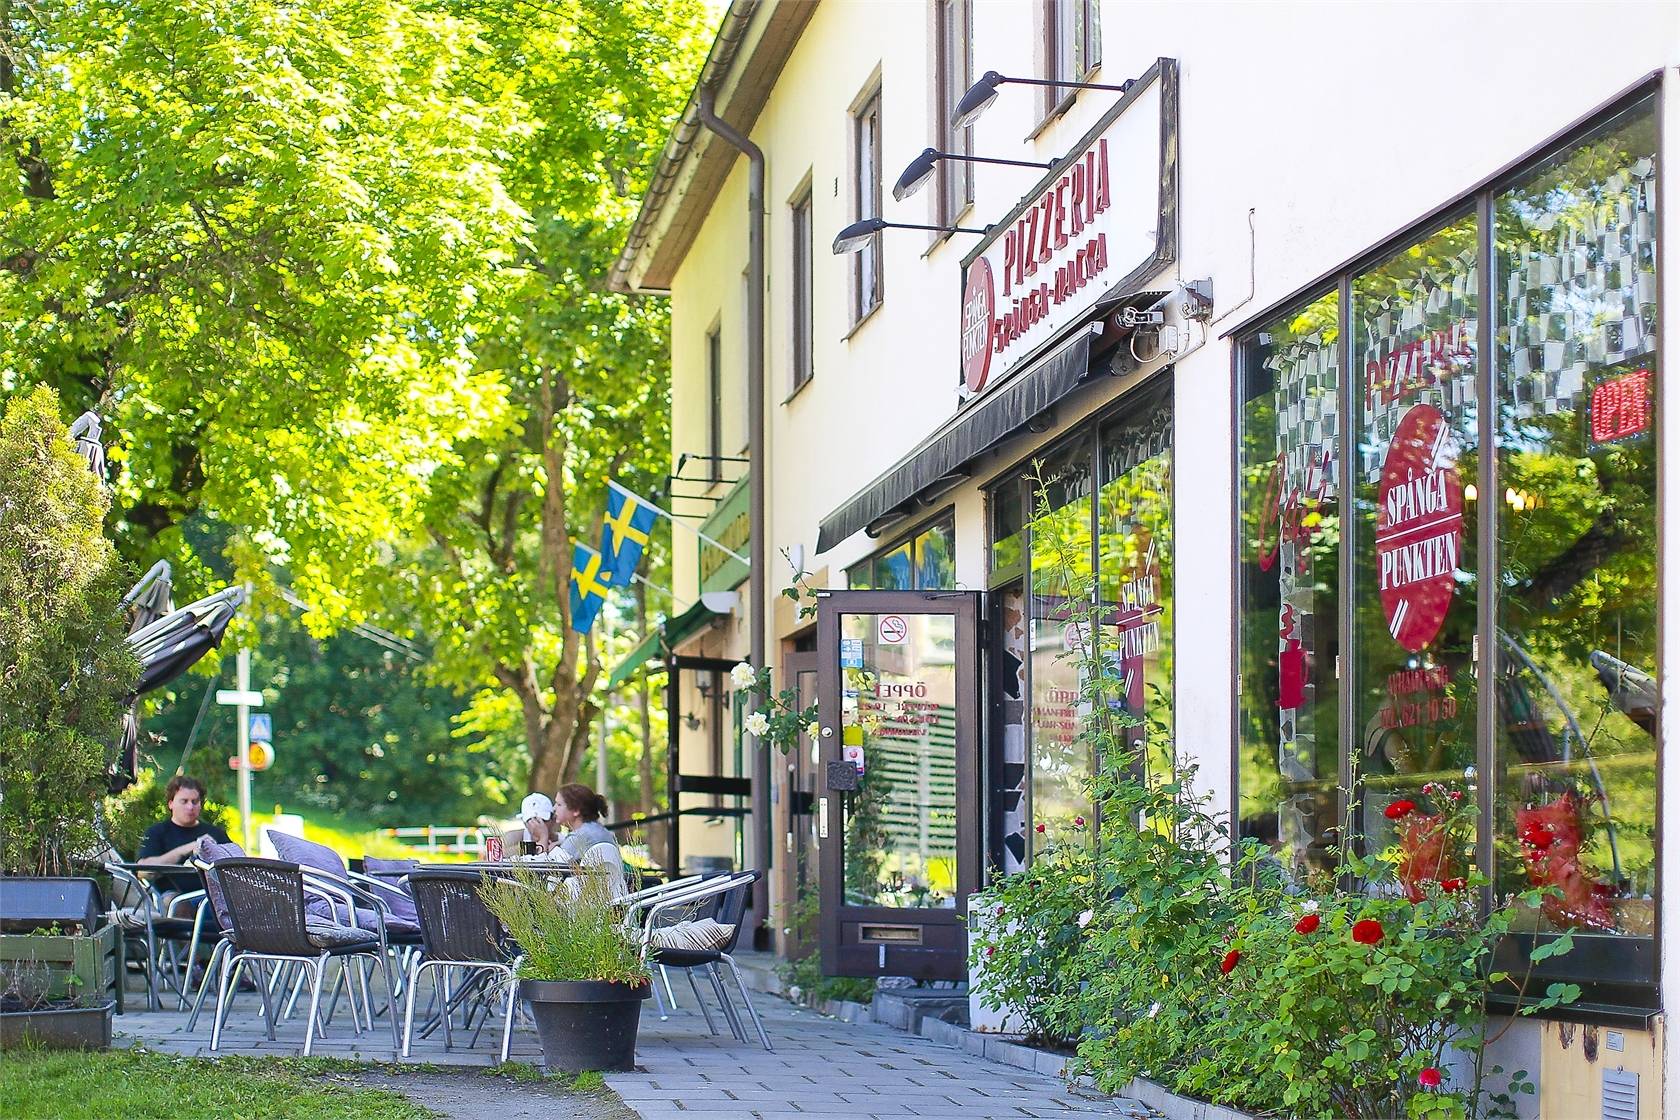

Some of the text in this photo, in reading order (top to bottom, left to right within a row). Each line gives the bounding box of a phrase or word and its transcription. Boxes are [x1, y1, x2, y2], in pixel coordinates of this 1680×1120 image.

[1003, 138, 1110, 296] PIZZERIA
[1387, 467, 1448, 528] SPÅNGA
[1380, 531, 1457, 591] PUNKTEN
[1121, 570, 1154, 613] SPÅNGA
[1119, 621, 1159, 661] PUNKTEN
